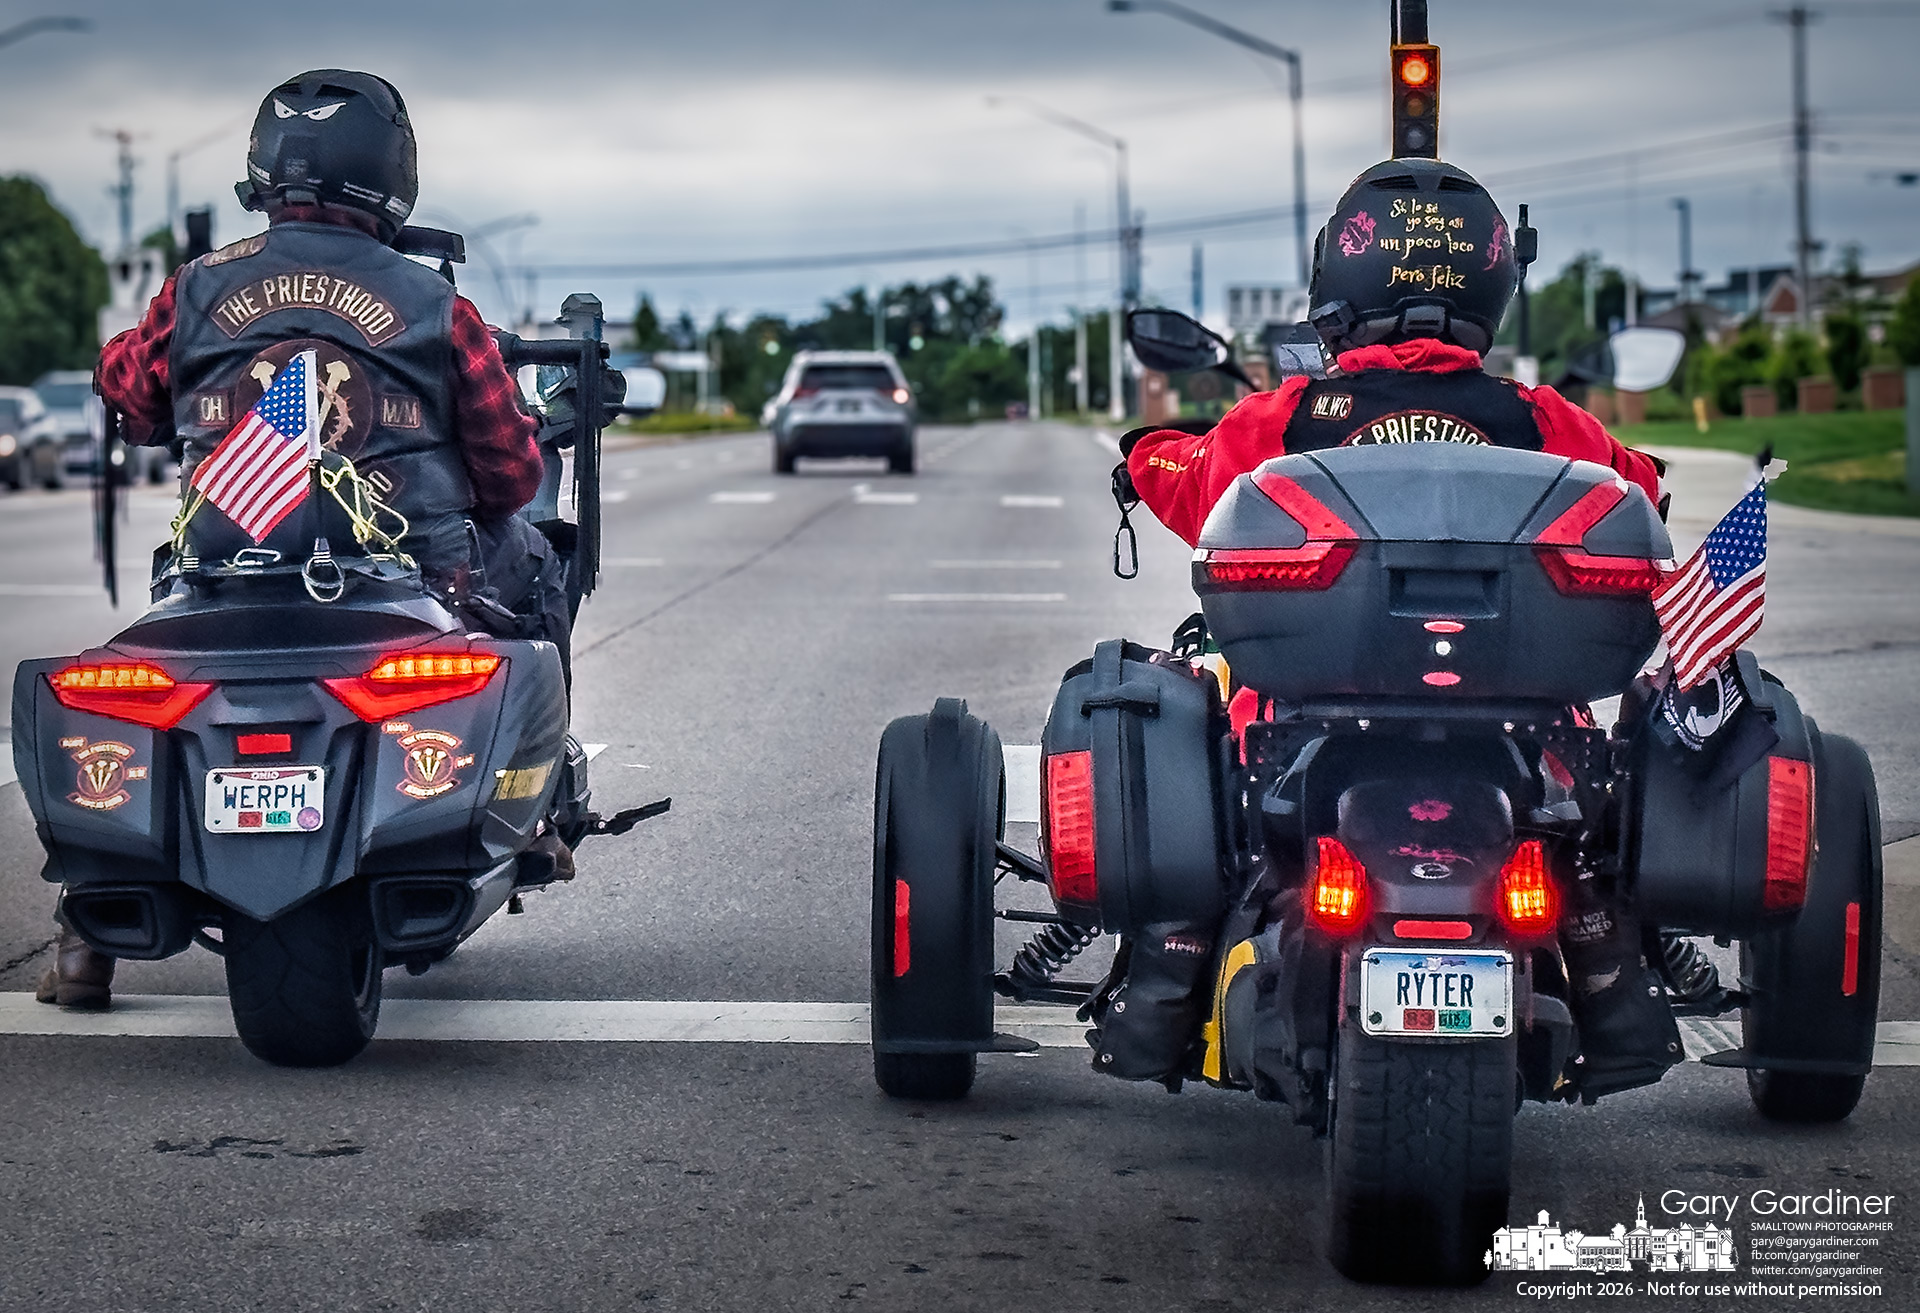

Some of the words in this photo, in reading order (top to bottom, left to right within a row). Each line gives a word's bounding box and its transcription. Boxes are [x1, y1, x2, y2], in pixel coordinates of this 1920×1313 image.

[1411, 198, 1422, 214] lo
[1405, 216, 1422, 232] yo
[1424, 216, 1445, 231] soy
[1380, 238, 1401, 251] un
[1401, 238, 1441, 260] poco
[1445, 232, 1475, 254] loco
[1424, 265, 1466, 291] feliz
[216, 287, 262, 327] THE
[262, 272, 395, 336] PRIESTHOOD
[224, 784, 305, 809] WERPH
[1397, 972, 1474, 1008] RYTER
